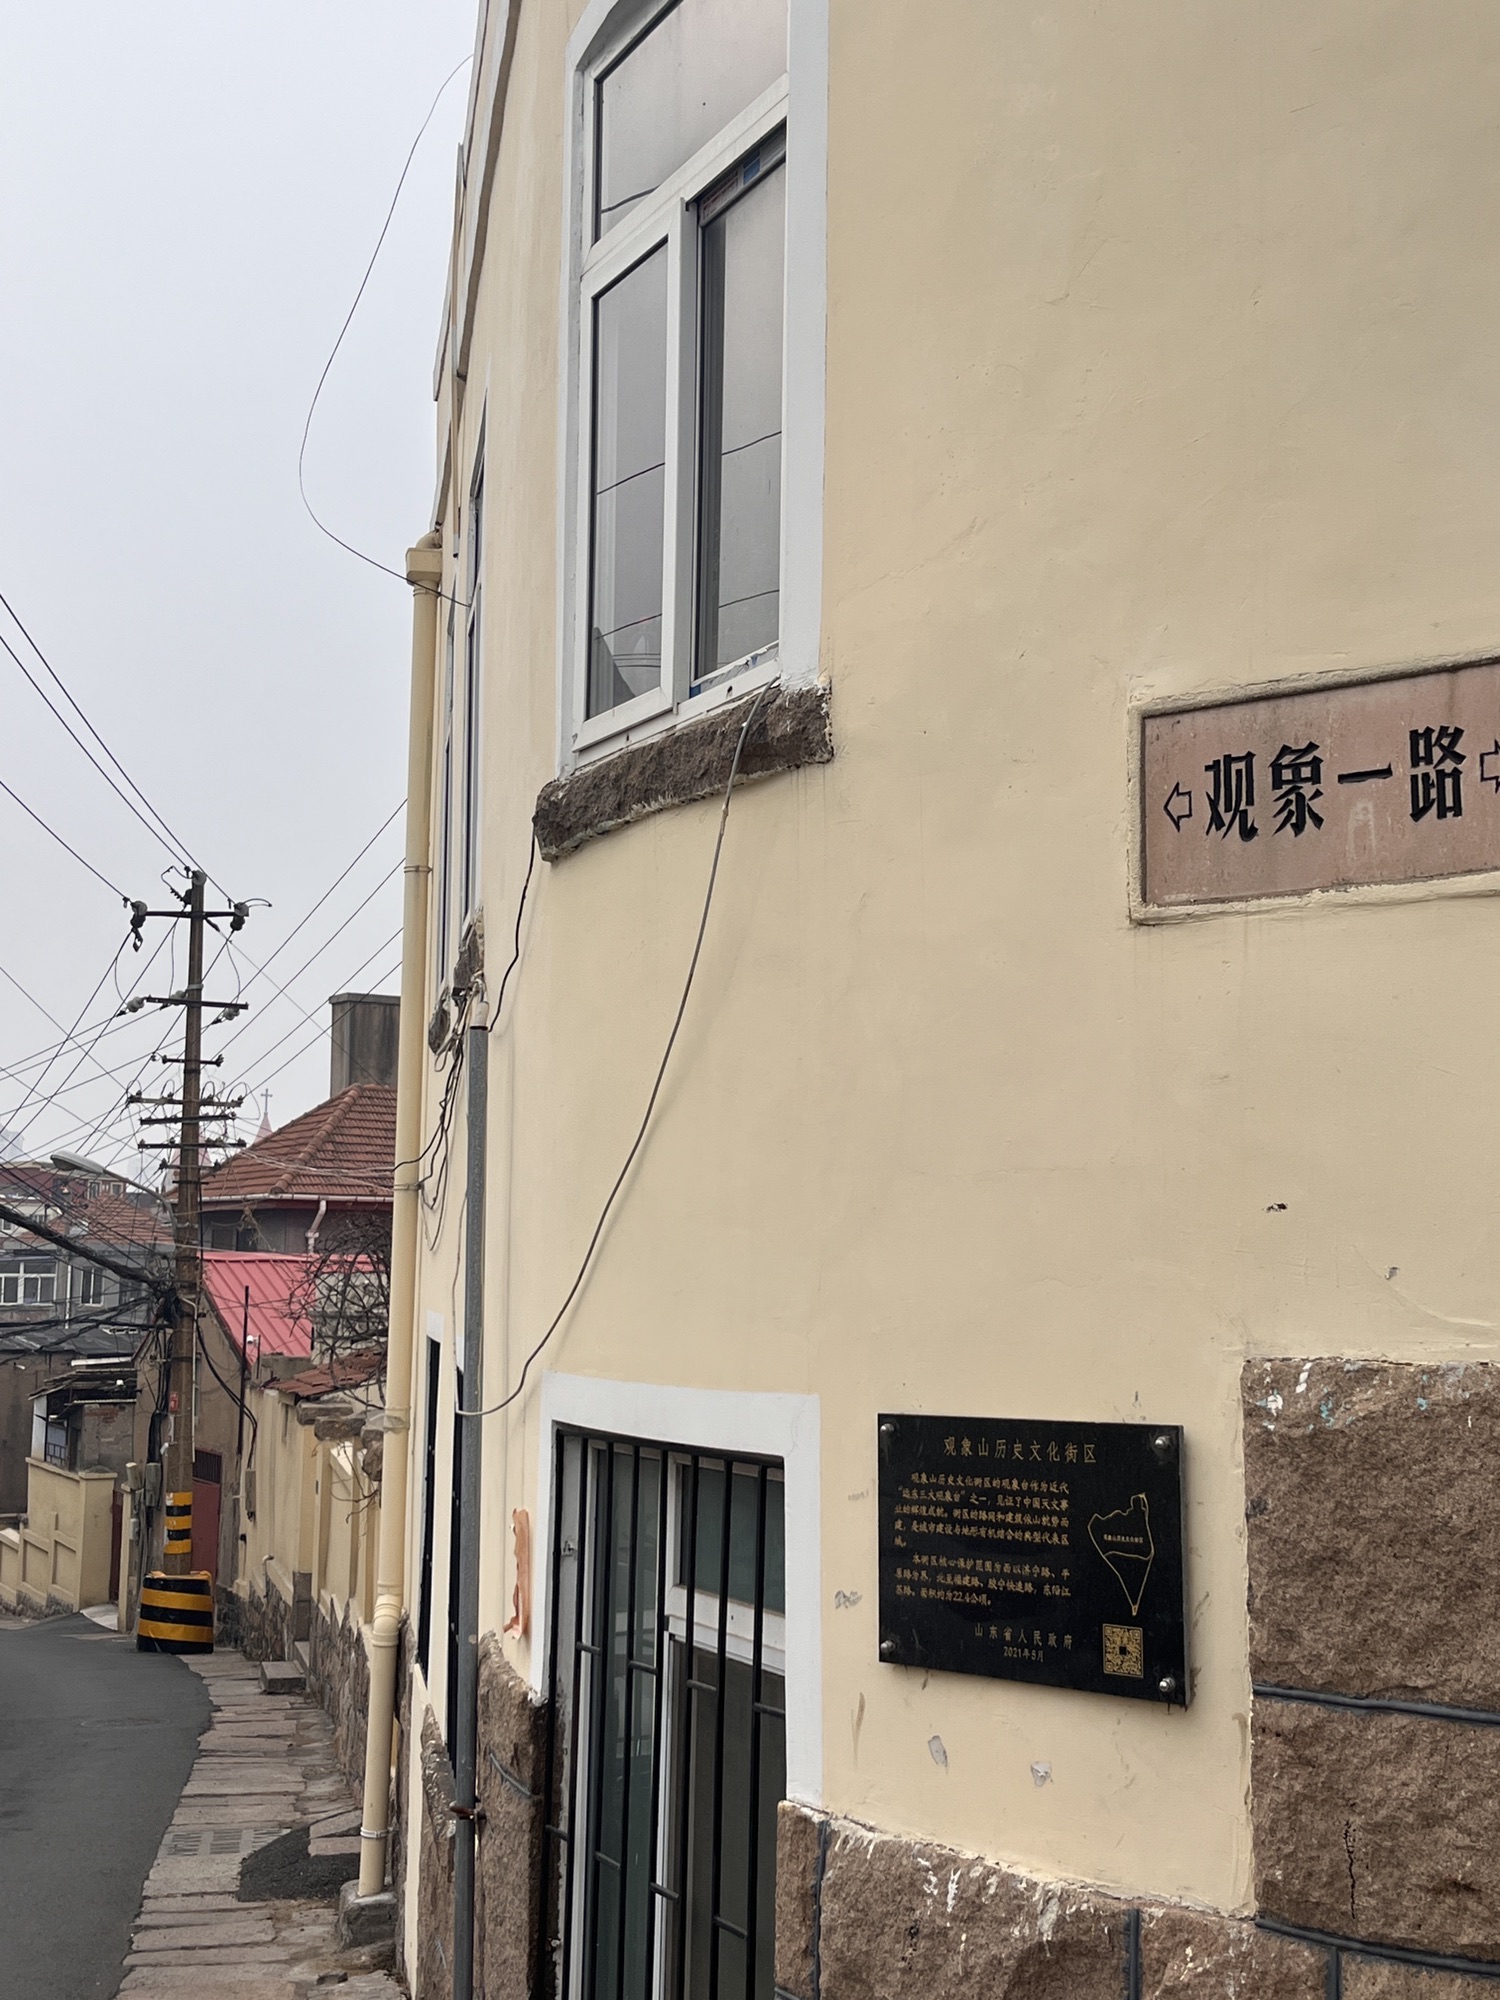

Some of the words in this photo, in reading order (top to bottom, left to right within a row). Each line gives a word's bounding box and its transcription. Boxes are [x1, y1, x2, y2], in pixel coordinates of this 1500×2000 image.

[1204, 725, 1467, 842] 观象一路
[944, 1438, 1098, 1464] 观象山历史文化街区
[974, 1622, 1073, 1650] 山东省人民政府
